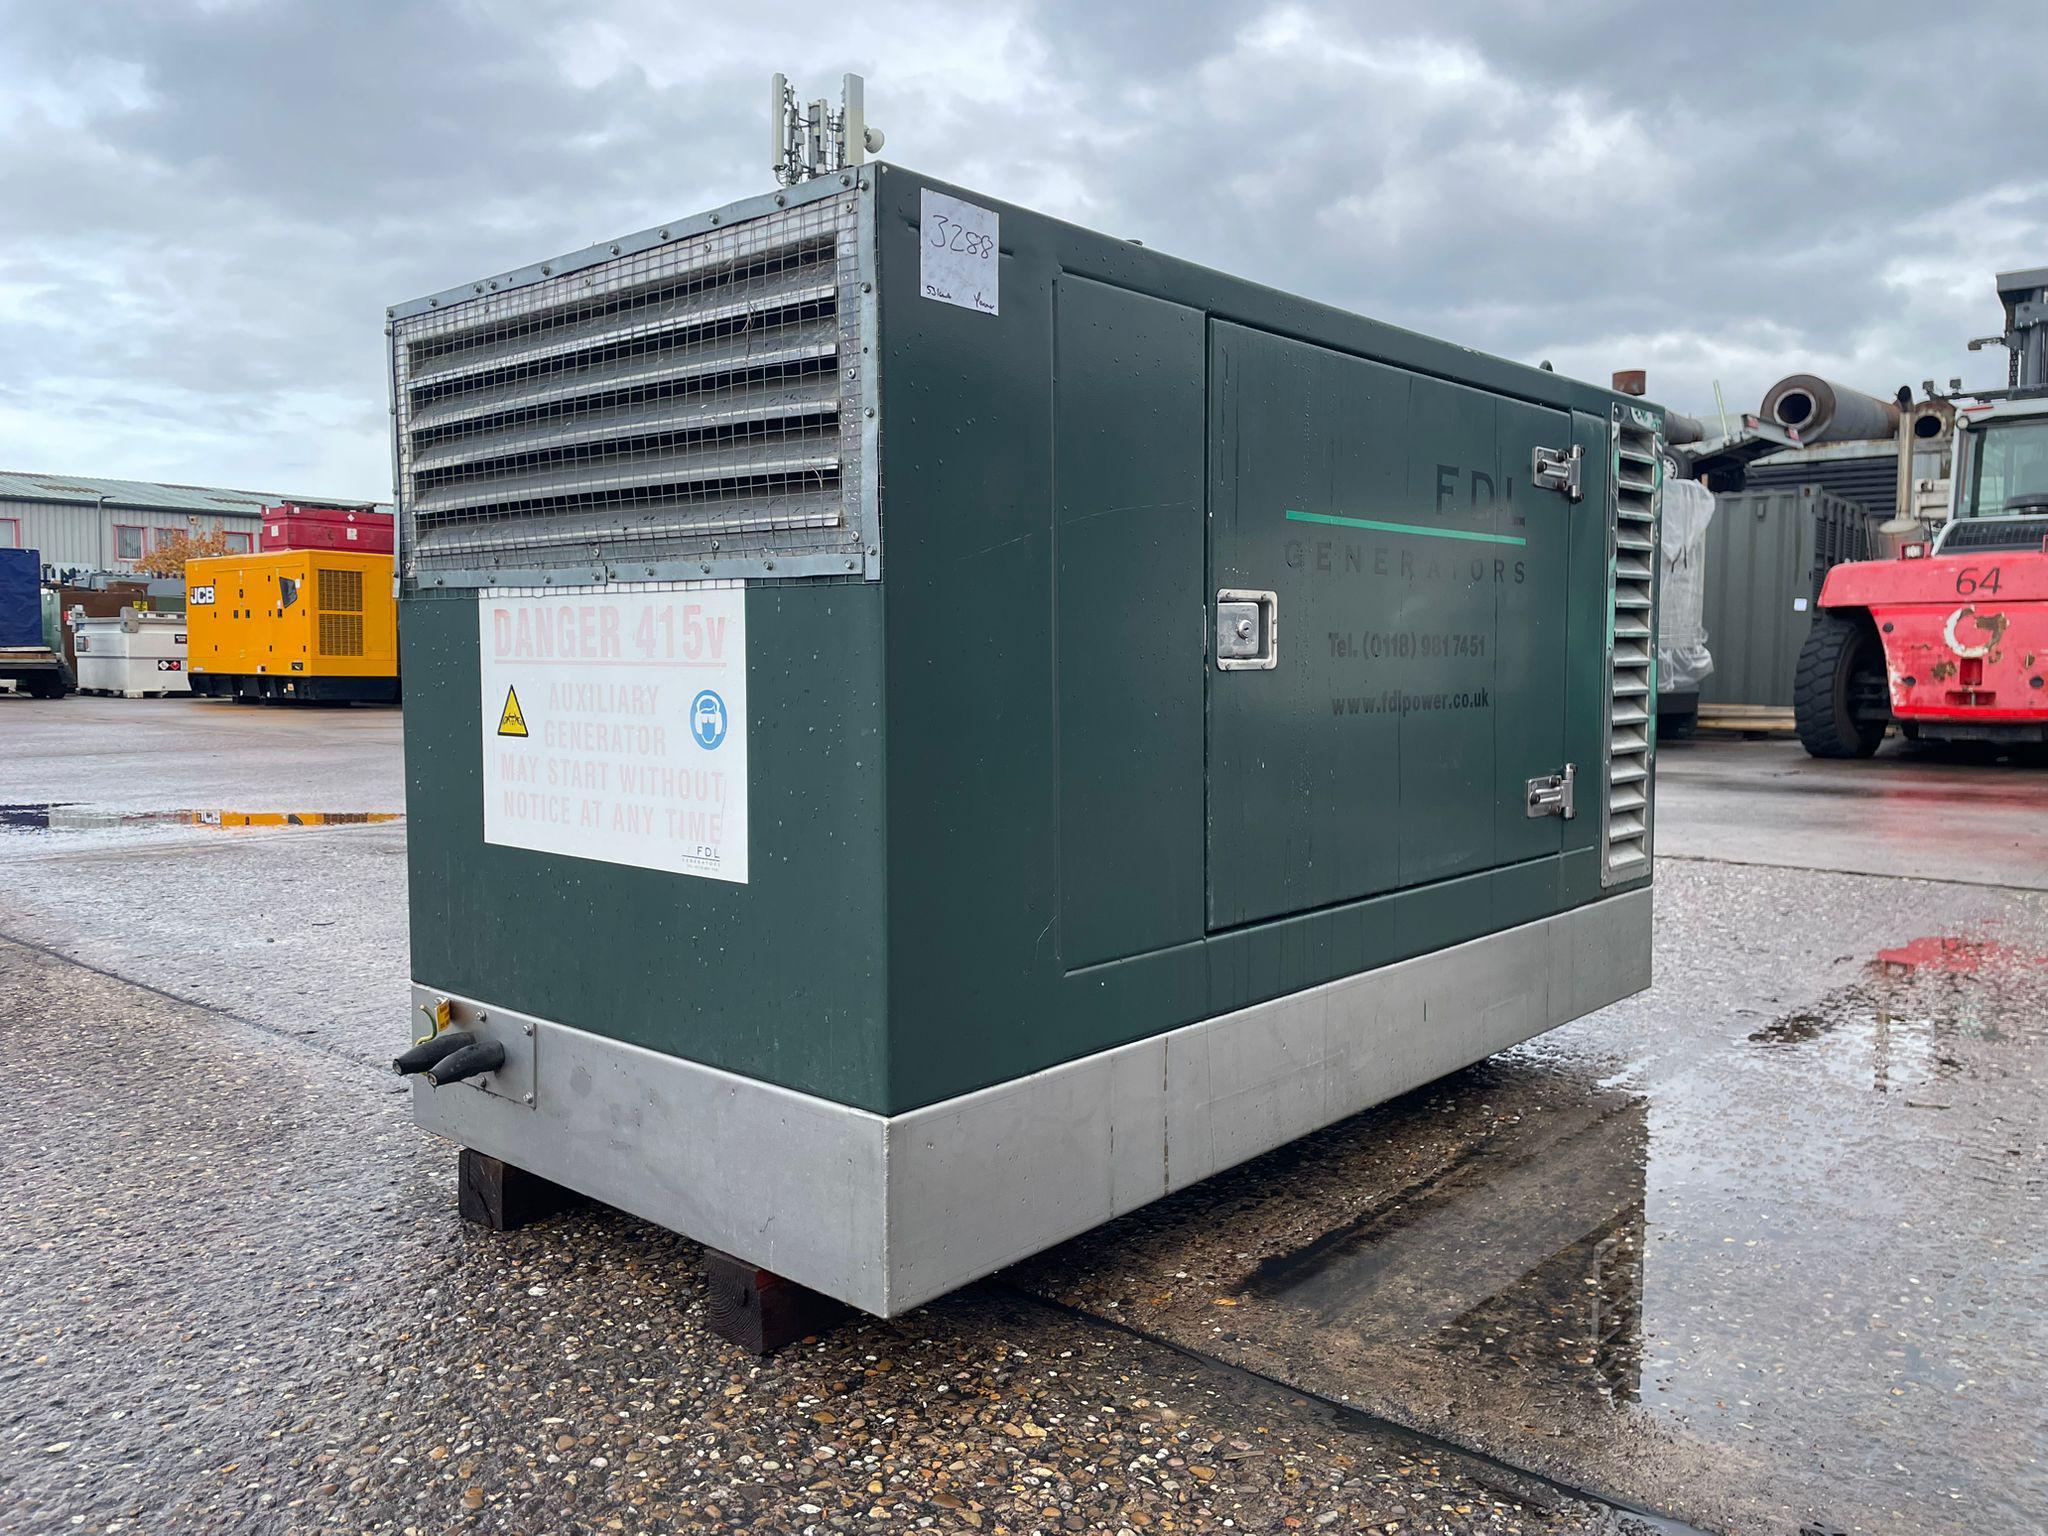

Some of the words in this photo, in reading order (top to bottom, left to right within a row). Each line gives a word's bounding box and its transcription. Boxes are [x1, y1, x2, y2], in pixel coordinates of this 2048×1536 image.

[930, 214, 994, 259] 3288
[1435, 463, 1526, 528] FDL
[1283, 538, 1526, 585] GENERATORS
[1956, 566, 2002, 596] 64
[190, 586, 215, 605] JCB
[493, 605, 621, 658] DANGER
[1328, 631, 1357, 659] Tel.
[1362, 629, 1416, 661] (0118)
[549, 682, 660, 716] AUXILIARY
[1331, 687, 1489, 717] www.fdlpower.co.uk
[543, 719, 667, 758] GENERATOR
[500, 752, 540, 785] MAY
[547, 758, 609, 792] START
[619, 763, 726, 803] WITHOUT
[502, 789, 571, 826] NOTICE
[580, 799, 603, 830] AT
[612, 802, 655, 836] ANY
[664, 808, 722, 844] TIME
[696, 846, 720, 860] FDL
